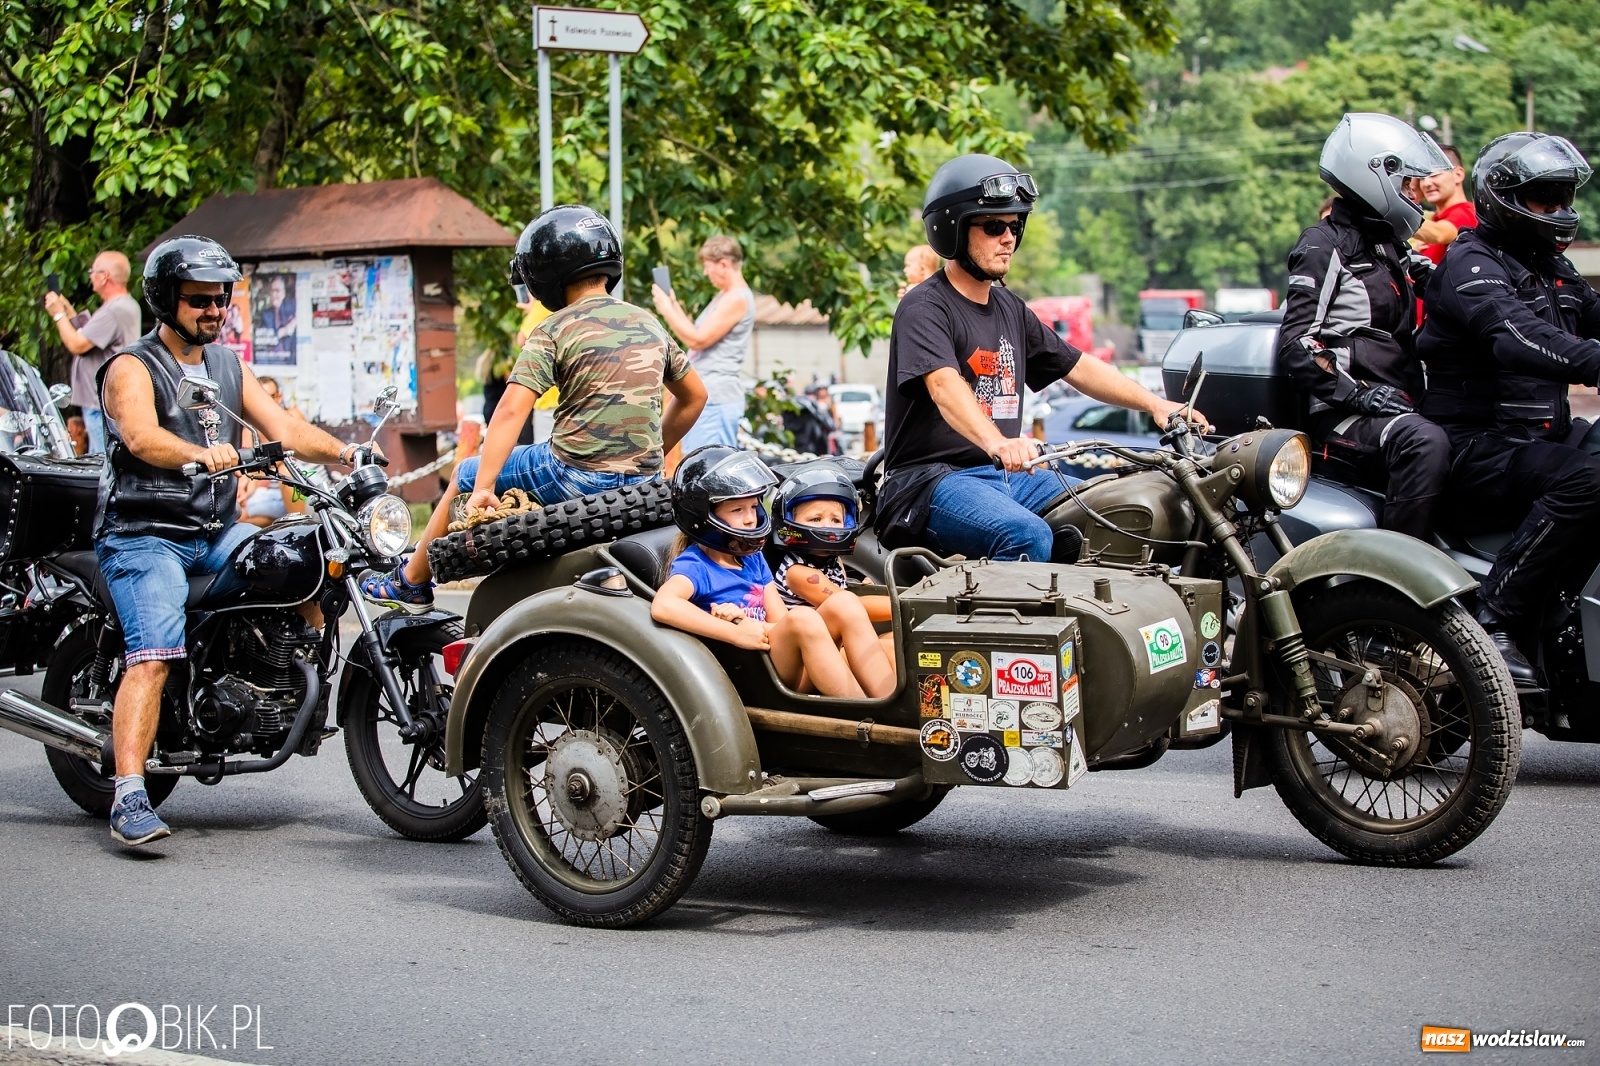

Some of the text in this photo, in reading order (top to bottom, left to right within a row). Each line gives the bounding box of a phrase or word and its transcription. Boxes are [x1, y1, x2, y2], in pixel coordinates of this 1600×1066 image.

[1014, 666, 1034, 680] 106
[1037, 673, 1049, 682] 2012
[998, 678, 1029, 695] PRAJZSKÁ
[1029, 681, 1052, 696] RALLYE
